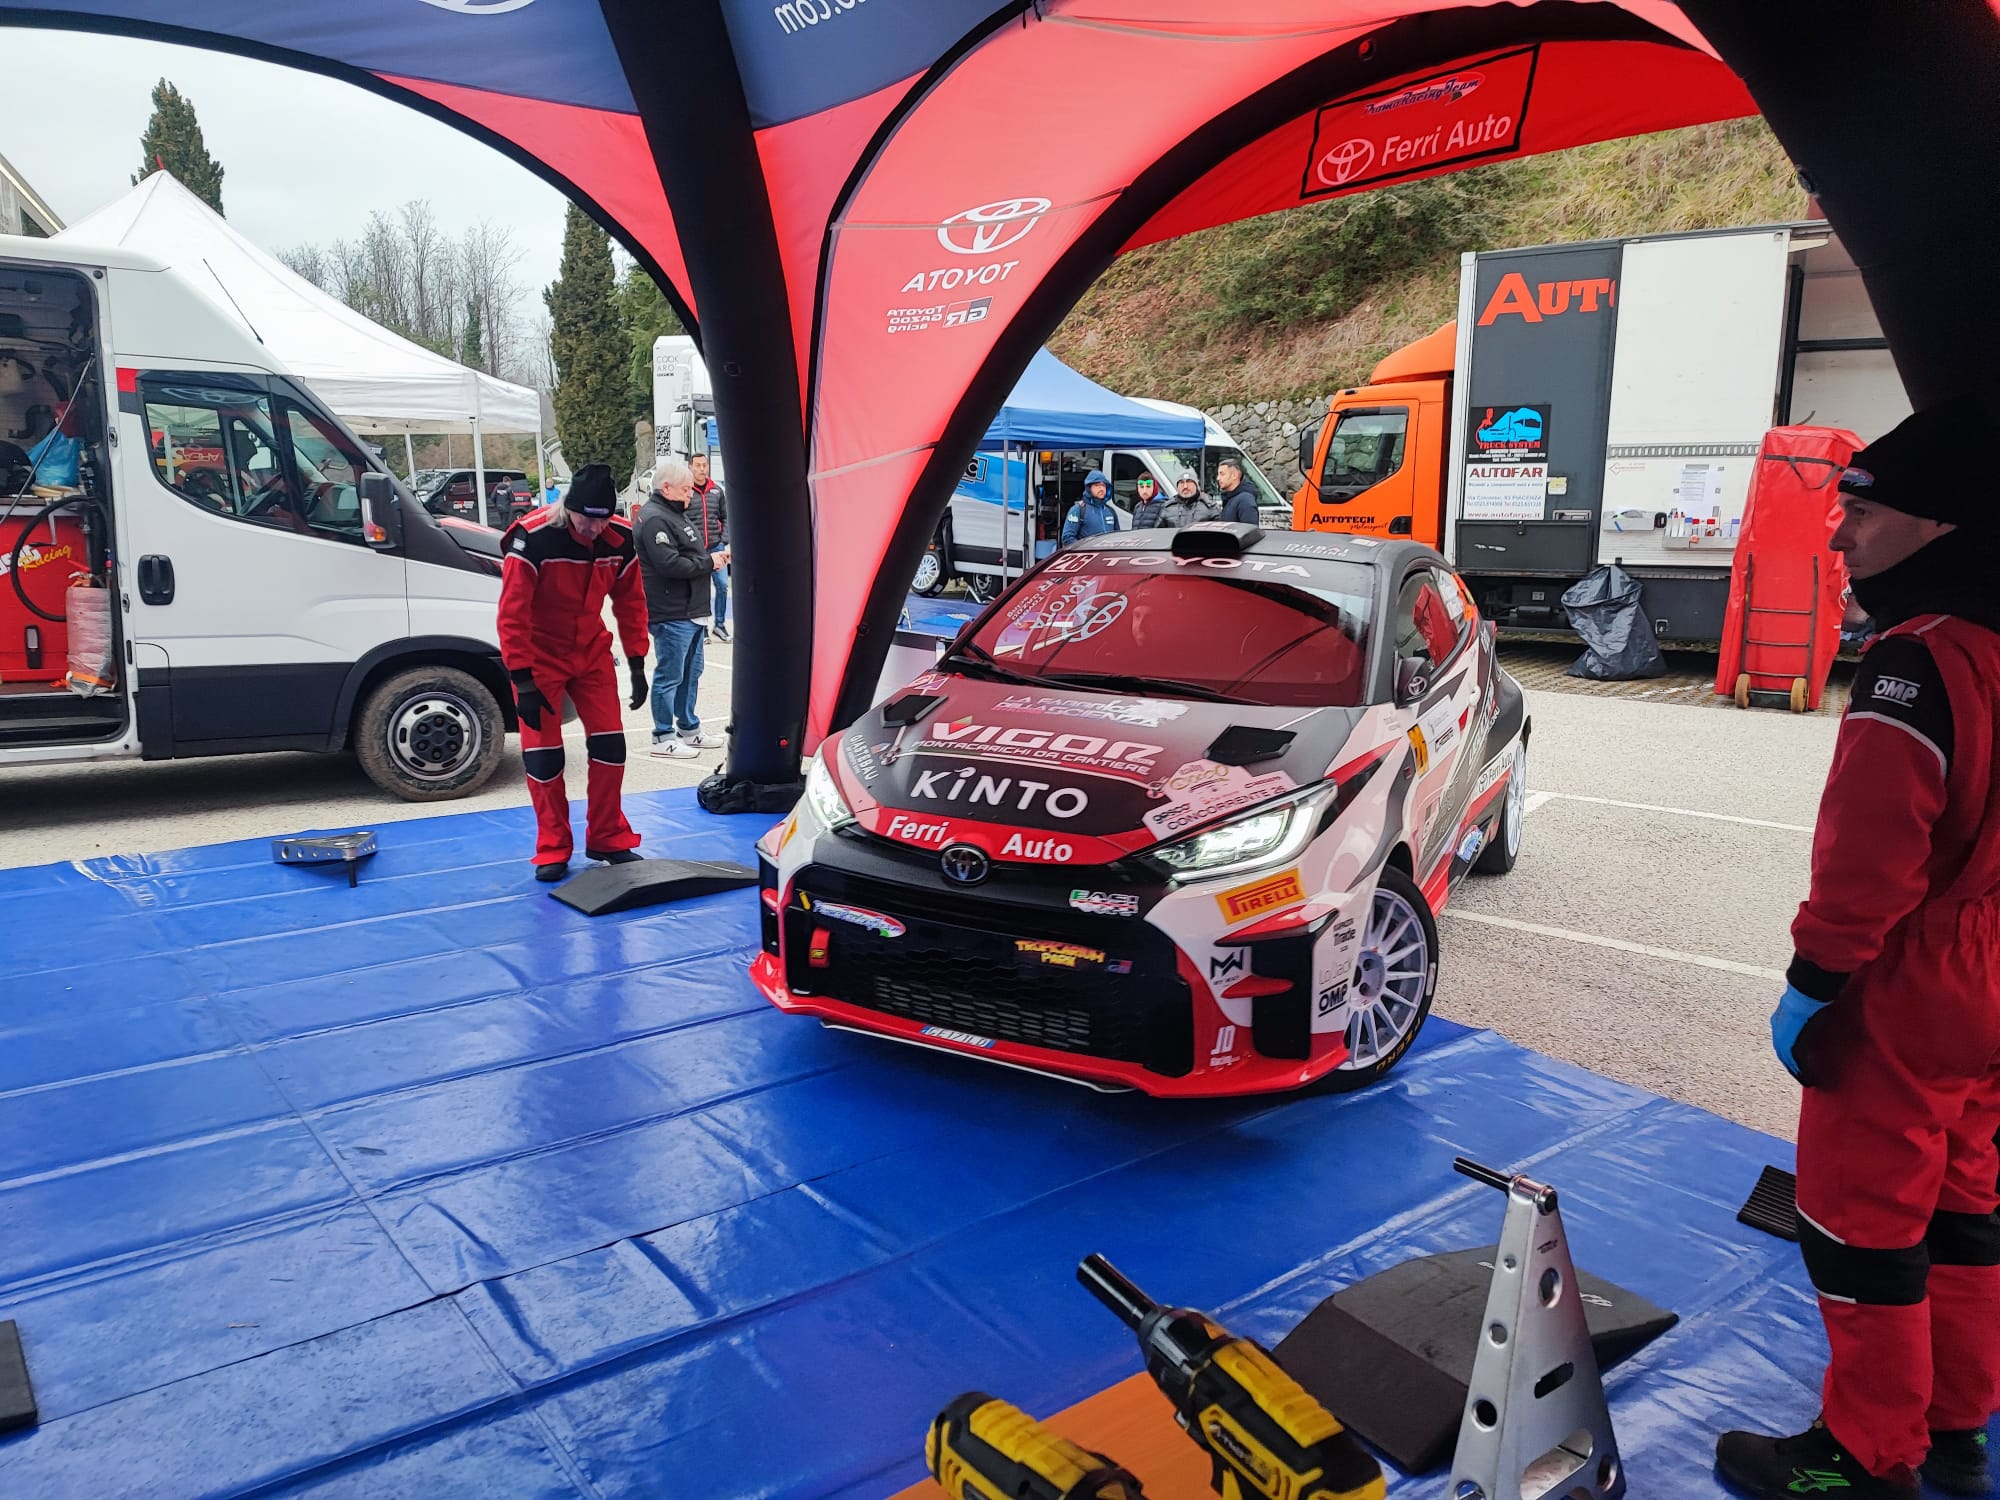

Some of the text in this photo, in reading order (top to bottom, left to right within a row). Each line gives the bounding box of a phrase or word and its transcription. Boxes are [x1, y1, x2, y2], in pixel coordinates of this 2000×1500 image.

[1381, 113, 1512, 166] Ferri Auto
[1469, 467, 1543, 478] AUTOFAR
[1102, 555, 1312, 578] TOYOTA
[1874, 679, 1919, 702] OMP
[932, 722, 1164, 765] VIGOR
[1032, 750, 1058, 759] DA
[1060, 753, 1152, 776] CANTIERE
[1167, 789, 1271, 830] CONCORRENTE
[886, 815, 1073, 862] Ferri Auto
[1226, 876, 1300, 917] PIRELLI
[1318, 983, 1348, 1012] OMP
